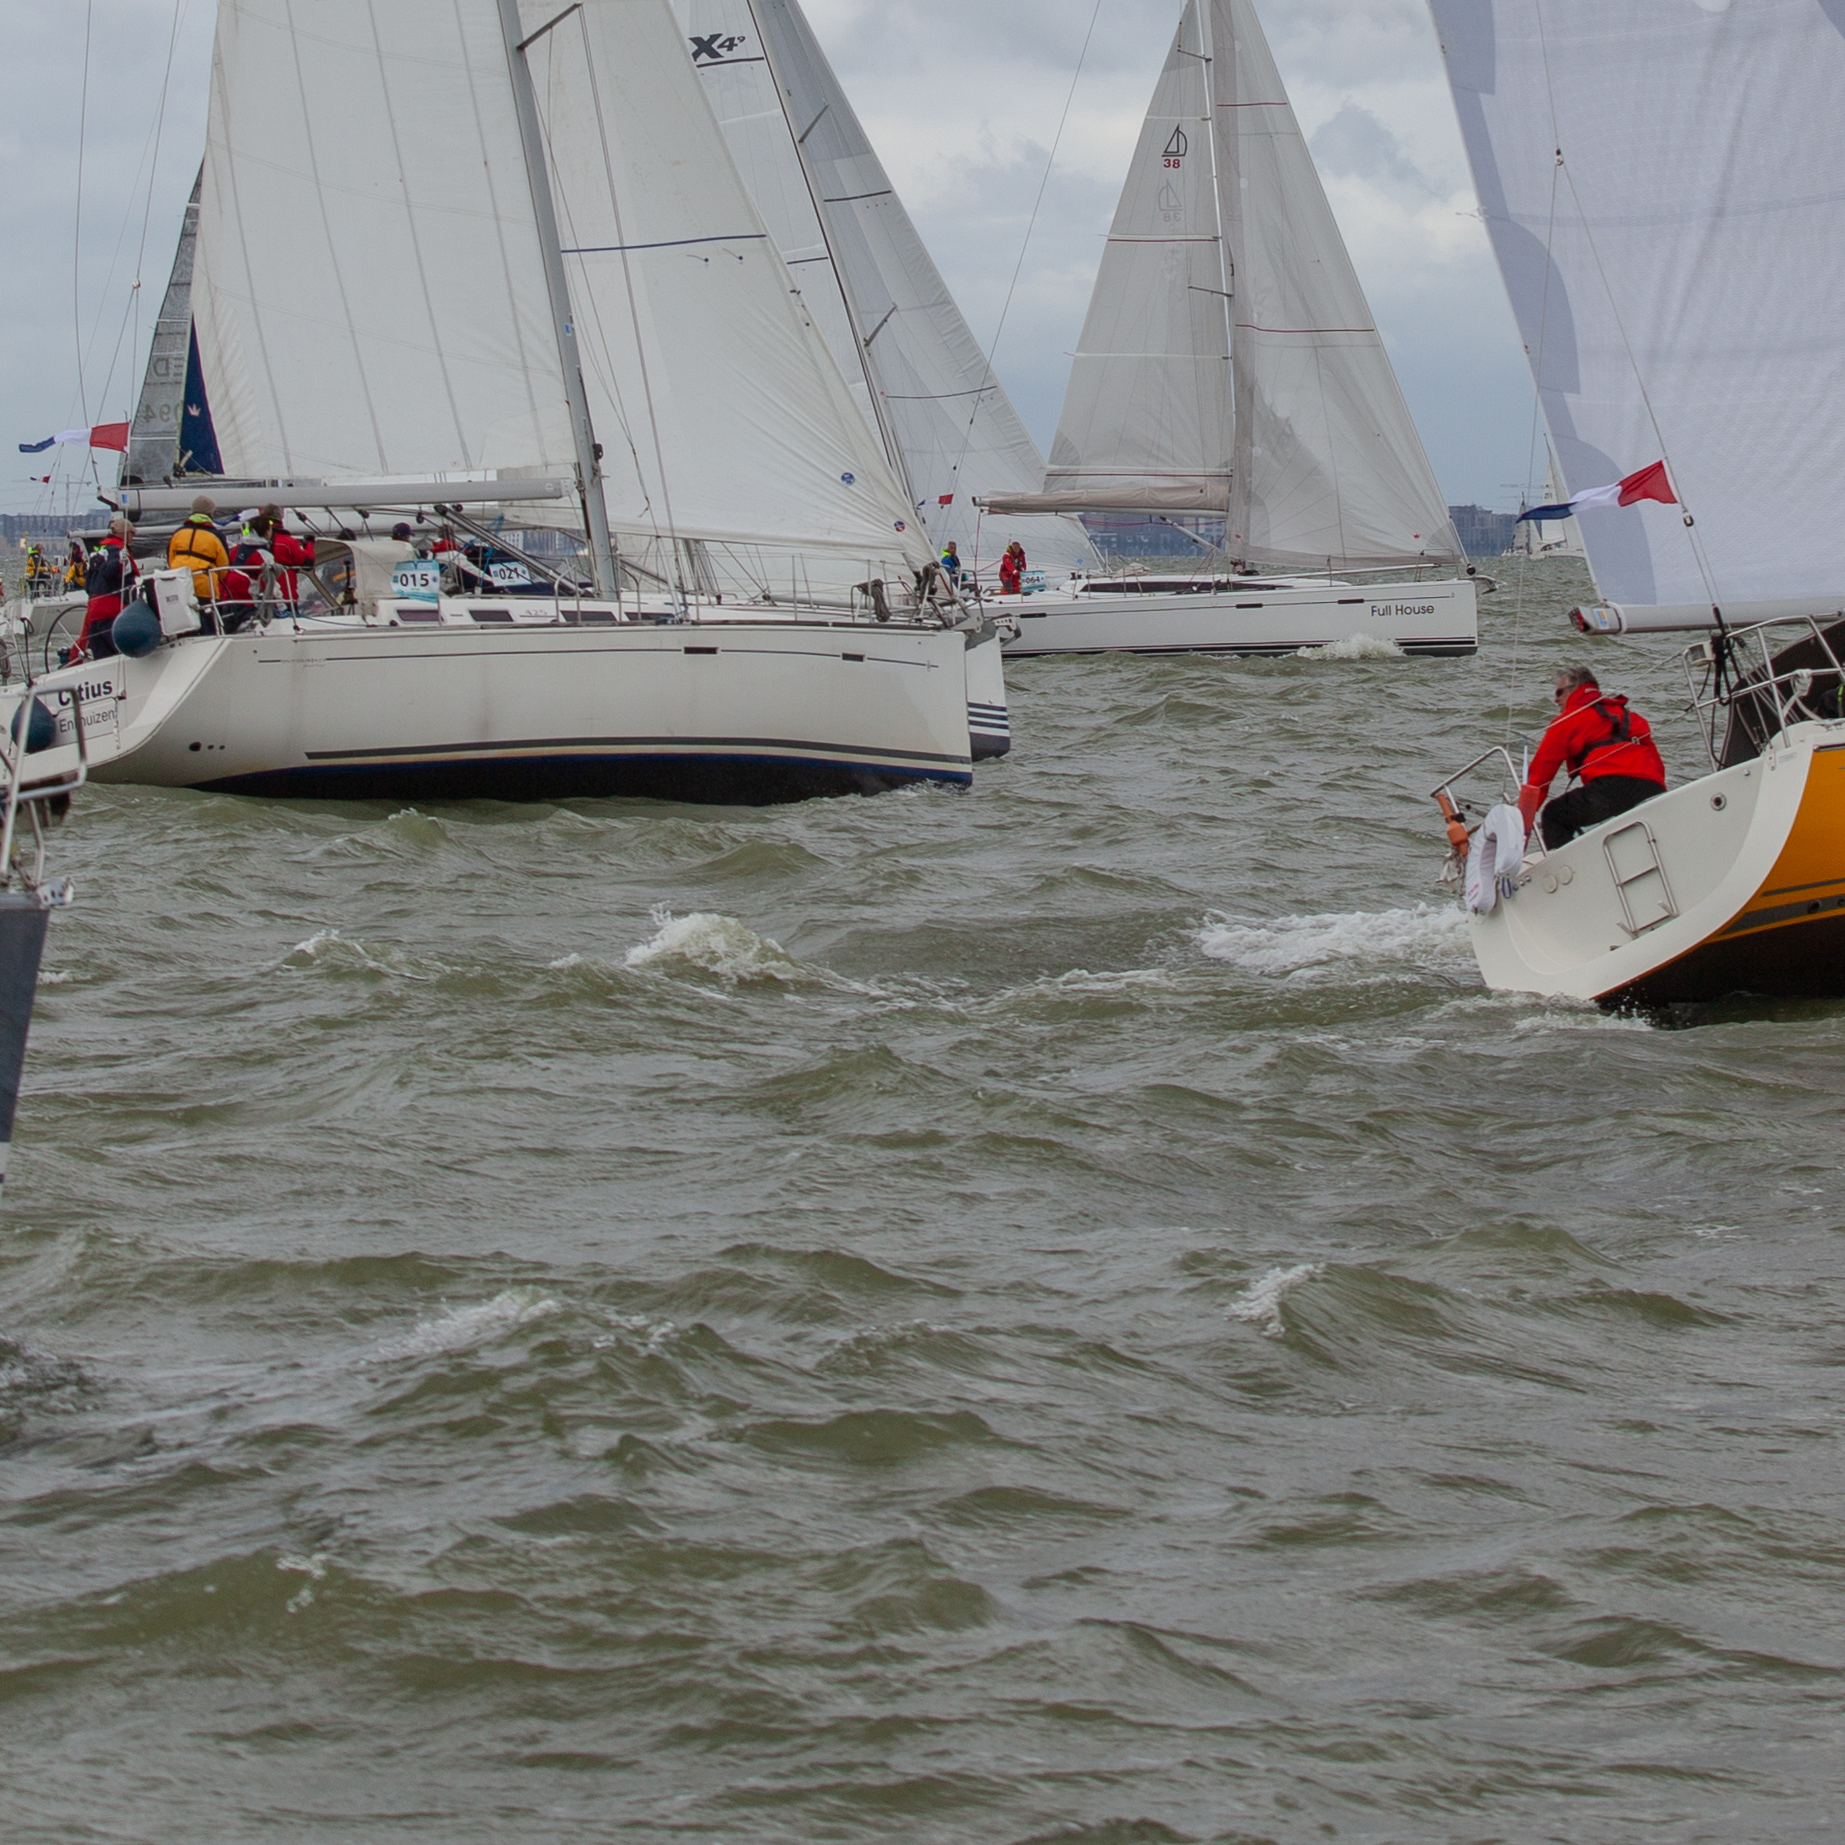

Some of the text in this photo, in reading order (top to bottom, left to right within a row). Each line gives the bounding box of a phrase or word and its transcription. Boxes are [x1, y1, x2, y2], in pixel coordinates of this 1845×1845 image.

[1163, 158, 1181, 169] 38
[400, 573, 429, 587] 015
[1371, 605, 1434, 617] Full House
[58, 680, 113, 706] Ctius
[59, 709, 115, 733] Enuizen
